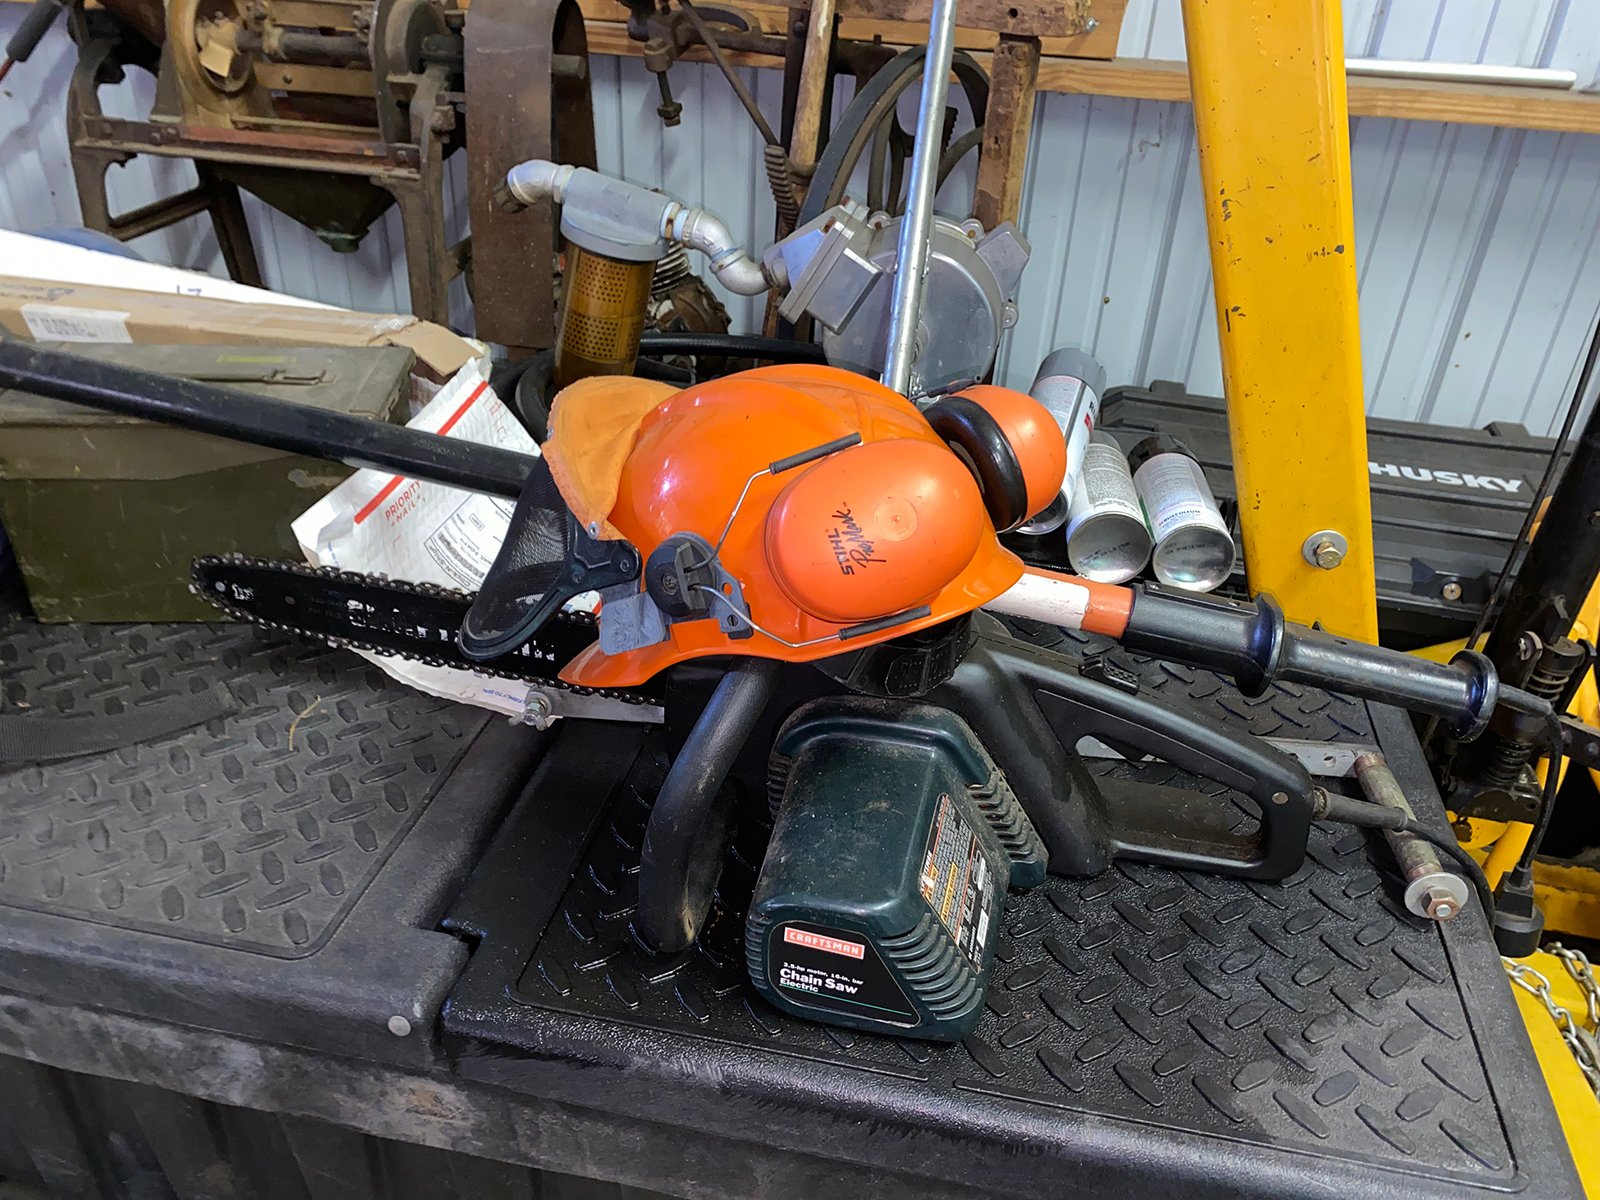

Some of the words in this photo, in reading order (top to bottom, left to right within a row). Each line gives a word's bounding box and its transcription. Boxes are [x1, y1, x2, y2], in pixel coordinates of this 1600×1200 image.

[1367, 461, 1523, 493] HUSKY
[385, 480, 421, 521] PRIORITY
[396, 500, 416, 523] MAIL
[828, 528, 855, 575] STIHL
[789, 931, 860, 955] CRAFTSMAN
[780, 968, 822, 987] Chain
[824, 977, 858, 995] Saw
[780, 977, 819, 993] Electric
